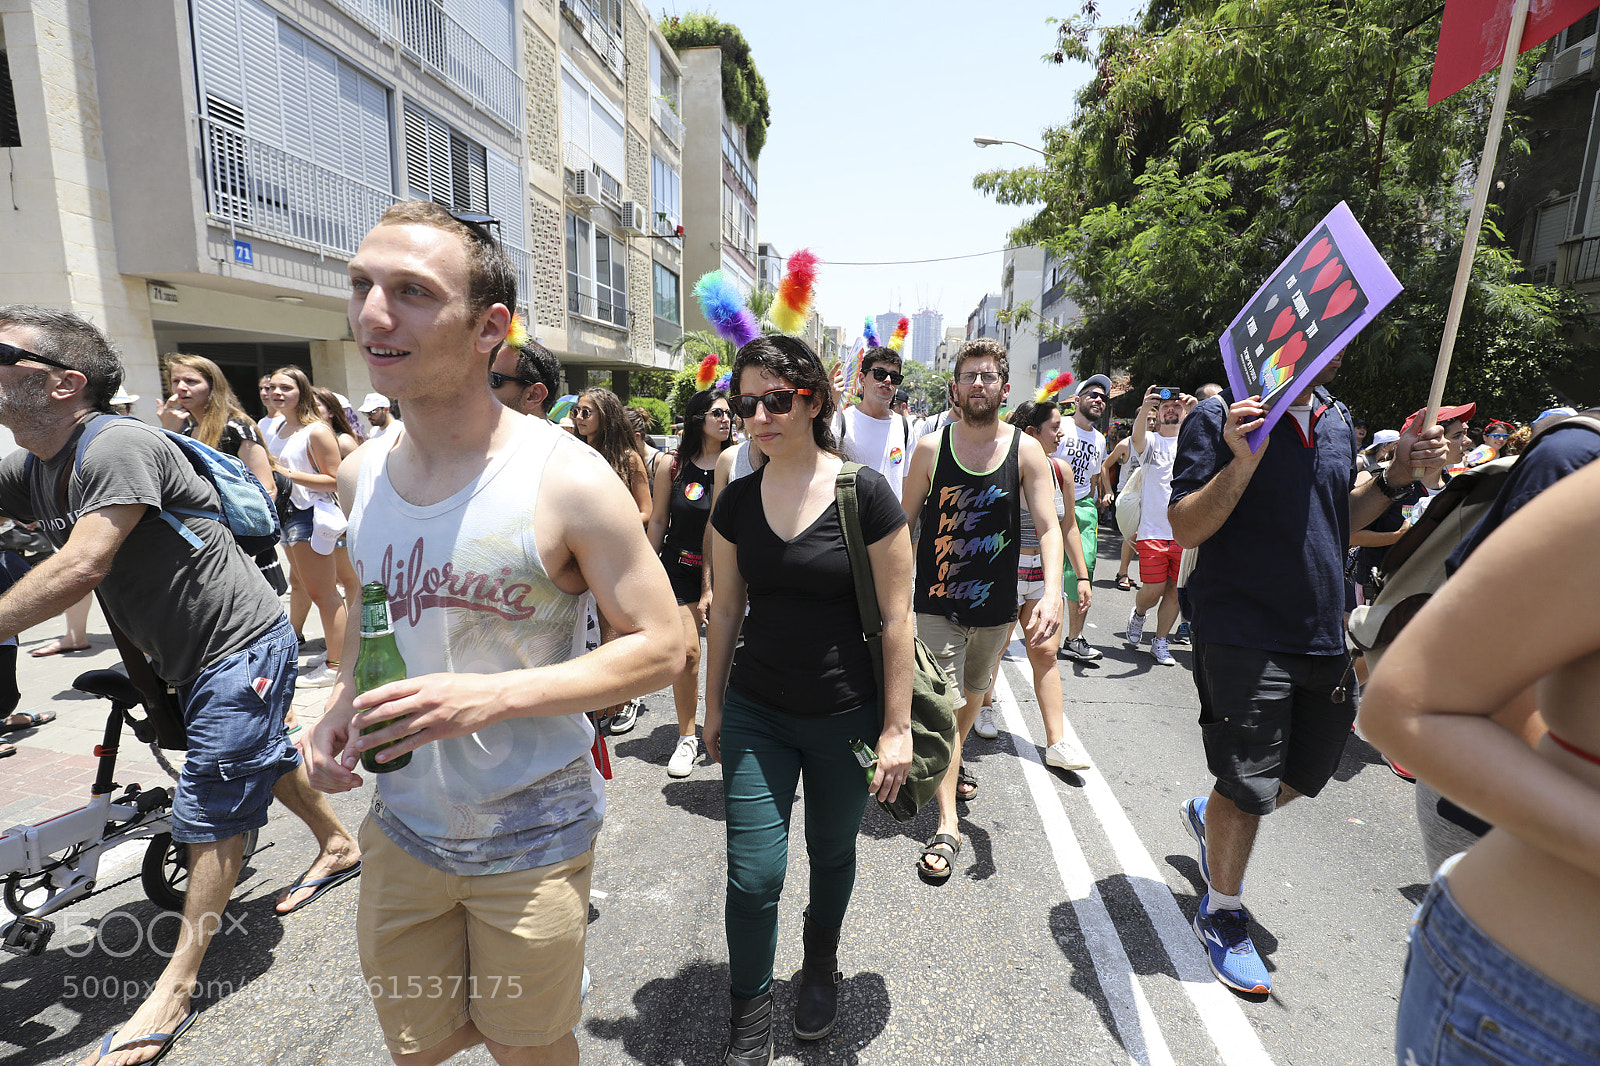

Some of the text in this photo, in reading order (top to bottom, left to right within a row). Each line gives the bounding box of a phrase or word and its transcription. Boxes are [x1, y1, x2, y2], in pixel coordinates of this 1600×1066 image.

[236, 246, 251, 260] 71
[1071, 457, 1090, 470] KILL
[1072, 466, 1085, 476] MY
[937, 561, 972, 581] OF
[356, 537, 536, 628] lifornia
